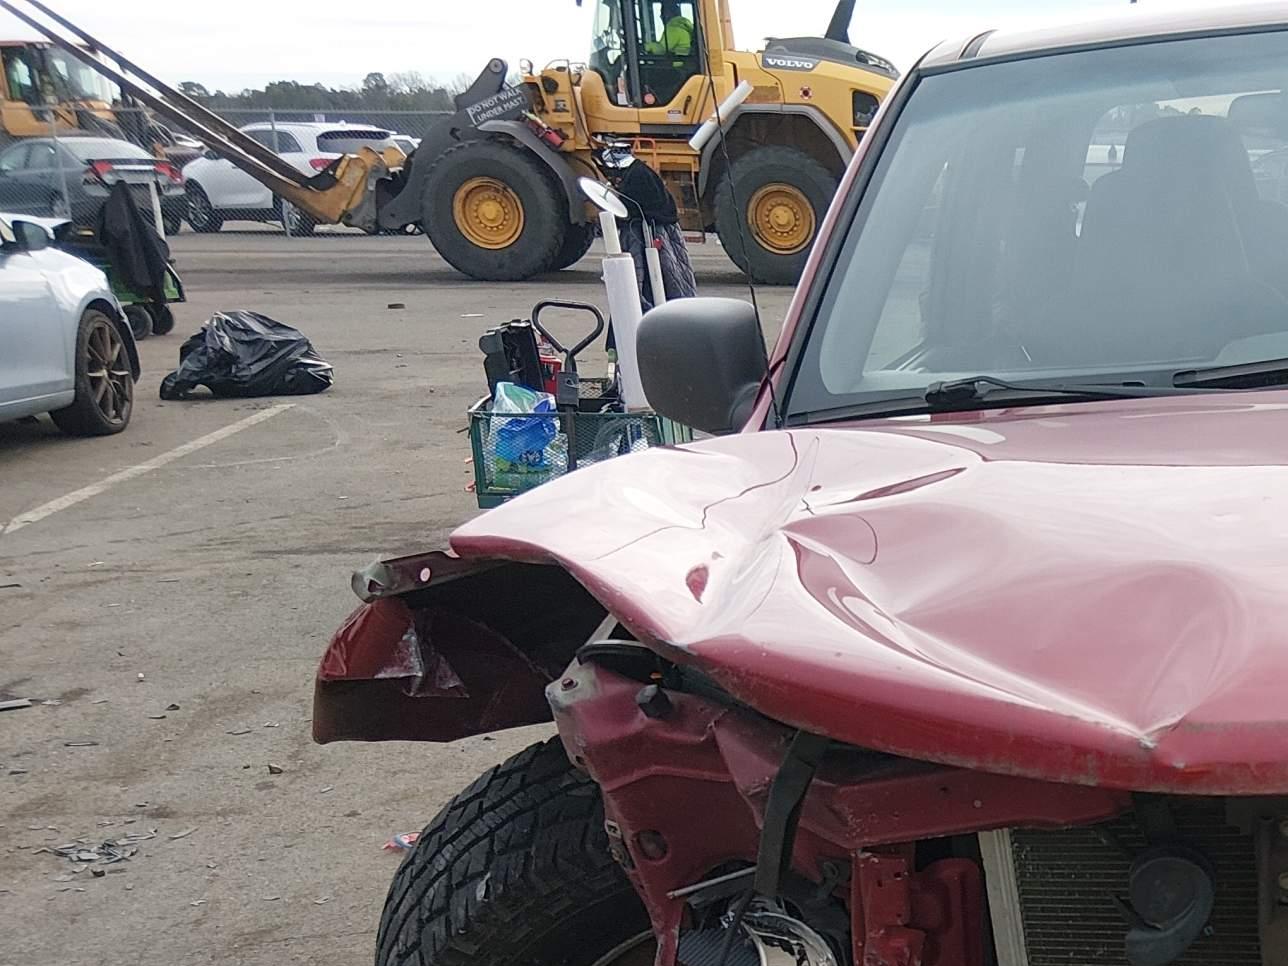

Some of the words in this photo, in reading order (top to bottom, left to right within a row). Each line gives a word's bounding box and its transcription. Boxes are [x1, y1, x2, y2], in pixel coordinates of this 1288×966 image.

[766, 58, 813, 69] VOLVO
[470, 103, 481, 115] DO
[481, 96, 499, 110] NOT
[500, 88, 522, 101] WALK
[477, 106, 502, 121] UNDER
[503, 97, 522, 111] MAST
